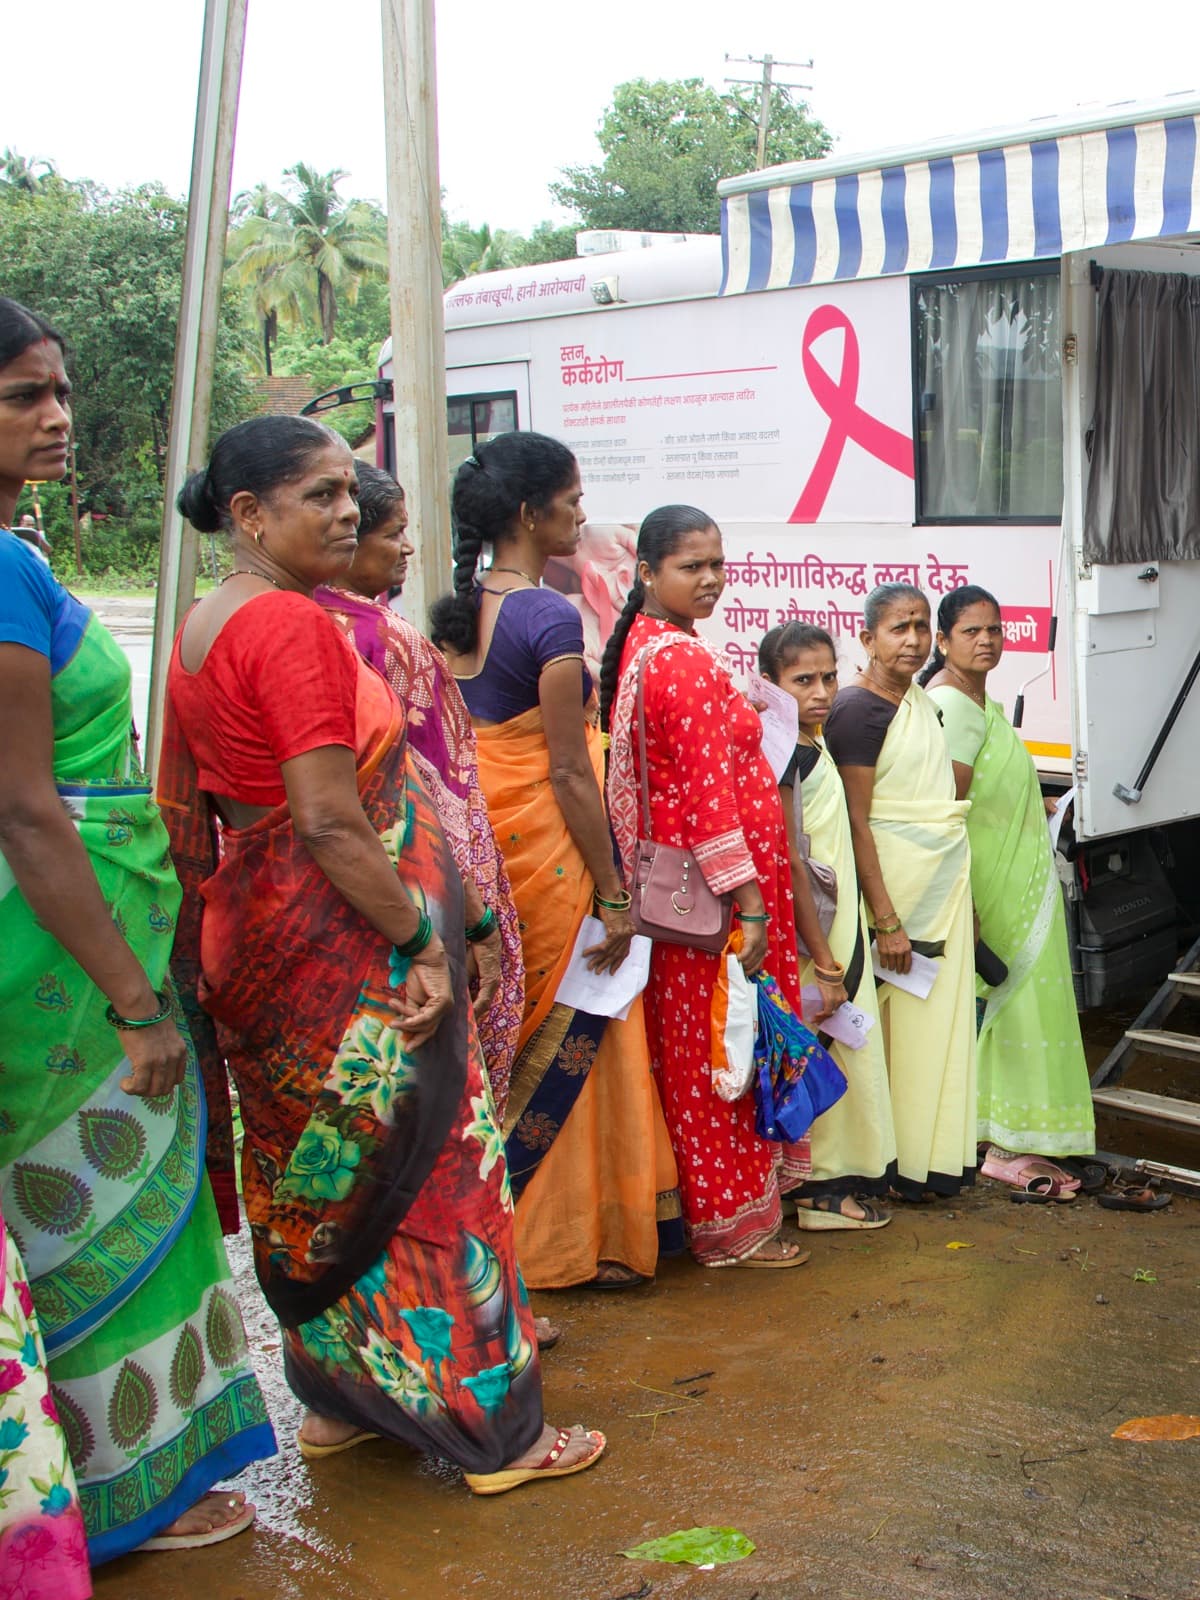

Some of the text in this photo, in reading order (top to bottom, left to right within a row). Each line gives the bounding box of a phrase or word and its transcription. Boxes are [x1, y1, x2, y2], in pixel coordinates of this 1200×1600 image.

[516, 280, 537, 301] हानी
[539, 274, 585, 296] आरोग्याची
[560, 345, 585, 361] स्तन
[561, 355, 624, 386] कर्करोग
[724, 552, 868, 594] कर्करोगाविरुद्ध
[723, 597, 769, 633] योग्य
[1112, 896, 1152, 917] HONDA
